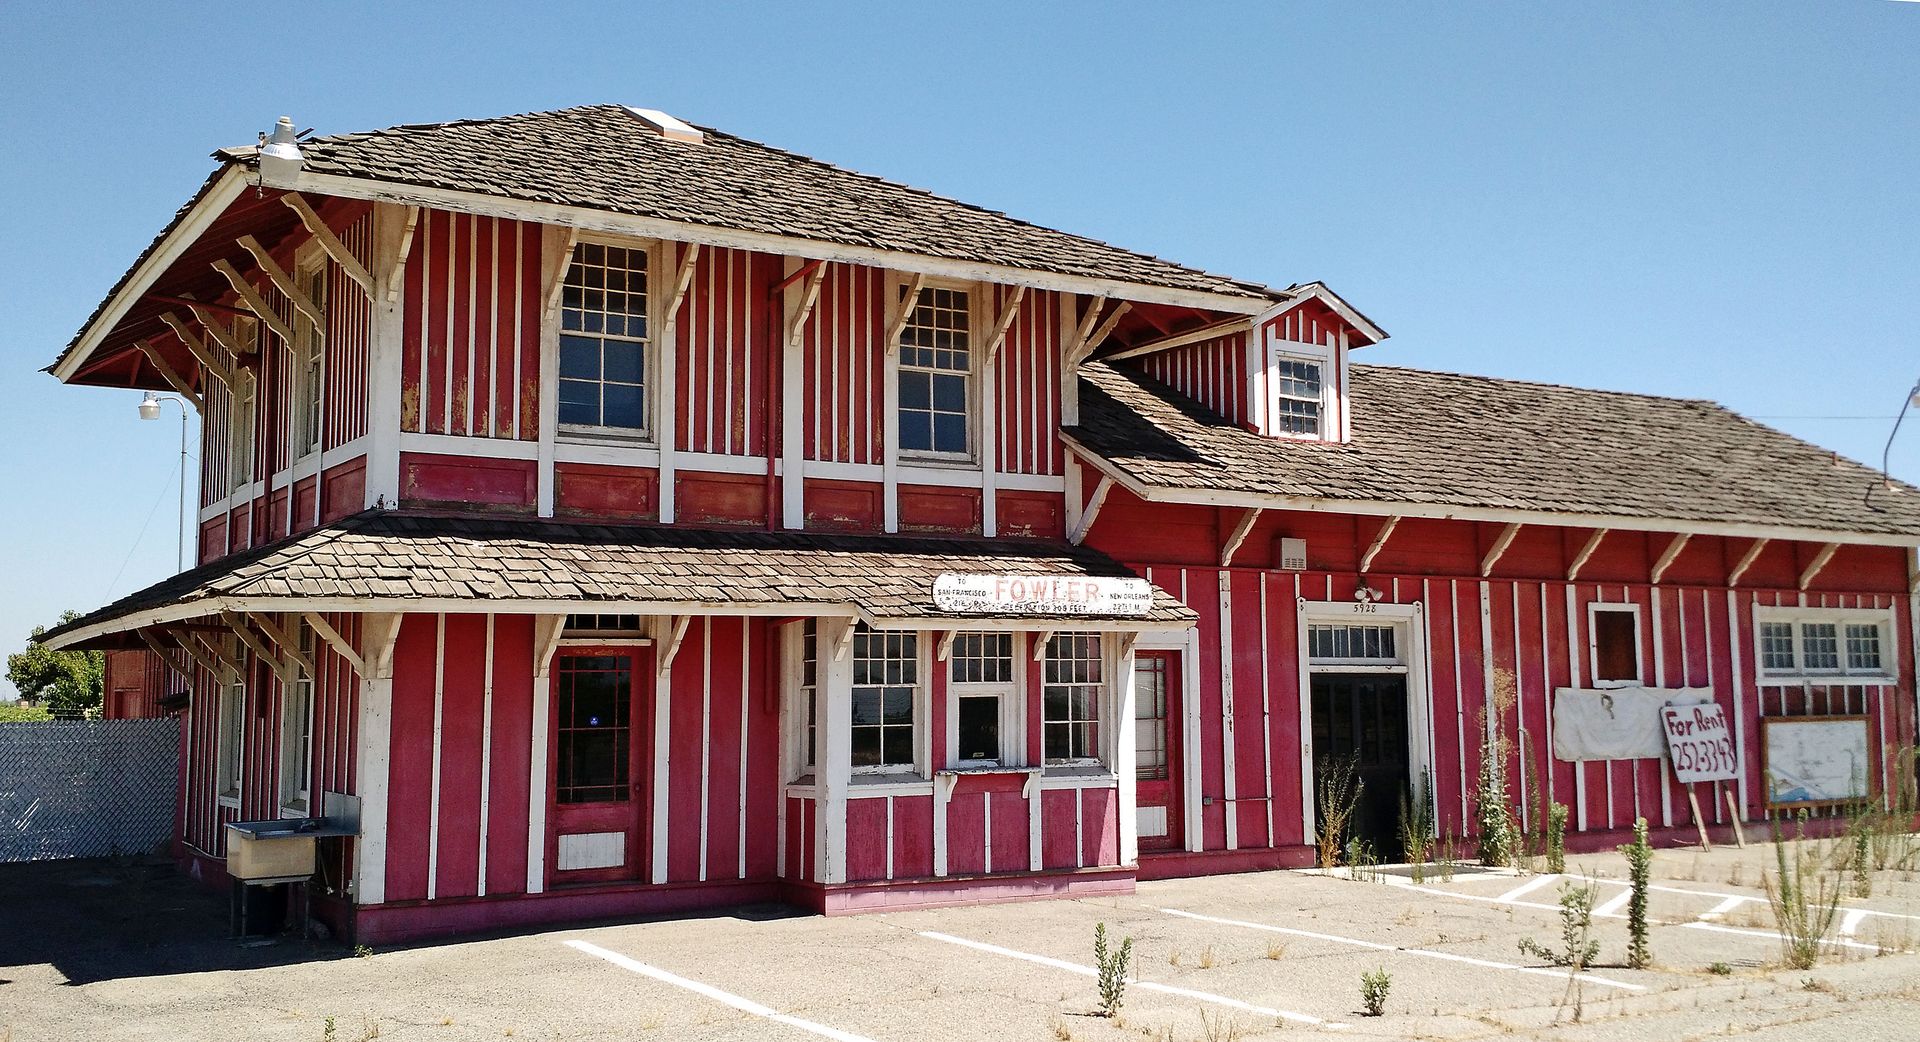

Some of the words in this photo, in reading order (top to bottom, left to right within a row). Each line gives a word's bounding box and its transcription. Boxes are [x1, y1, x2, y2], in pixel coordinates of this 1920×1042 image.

[938, 588, 951, 596] SAN
[952, 589, 986, 597] FRANCISCO
[995, 579, 1100, 603] FOWLER
[1125, 582, 1134, 590] TO
[1353, 604, 1377, 613] 5928
[1665, 711, 1693, 736] For
[1694, 708, 1725, 731] Rent
[1672, 738, 1736, 774] 252-3343
